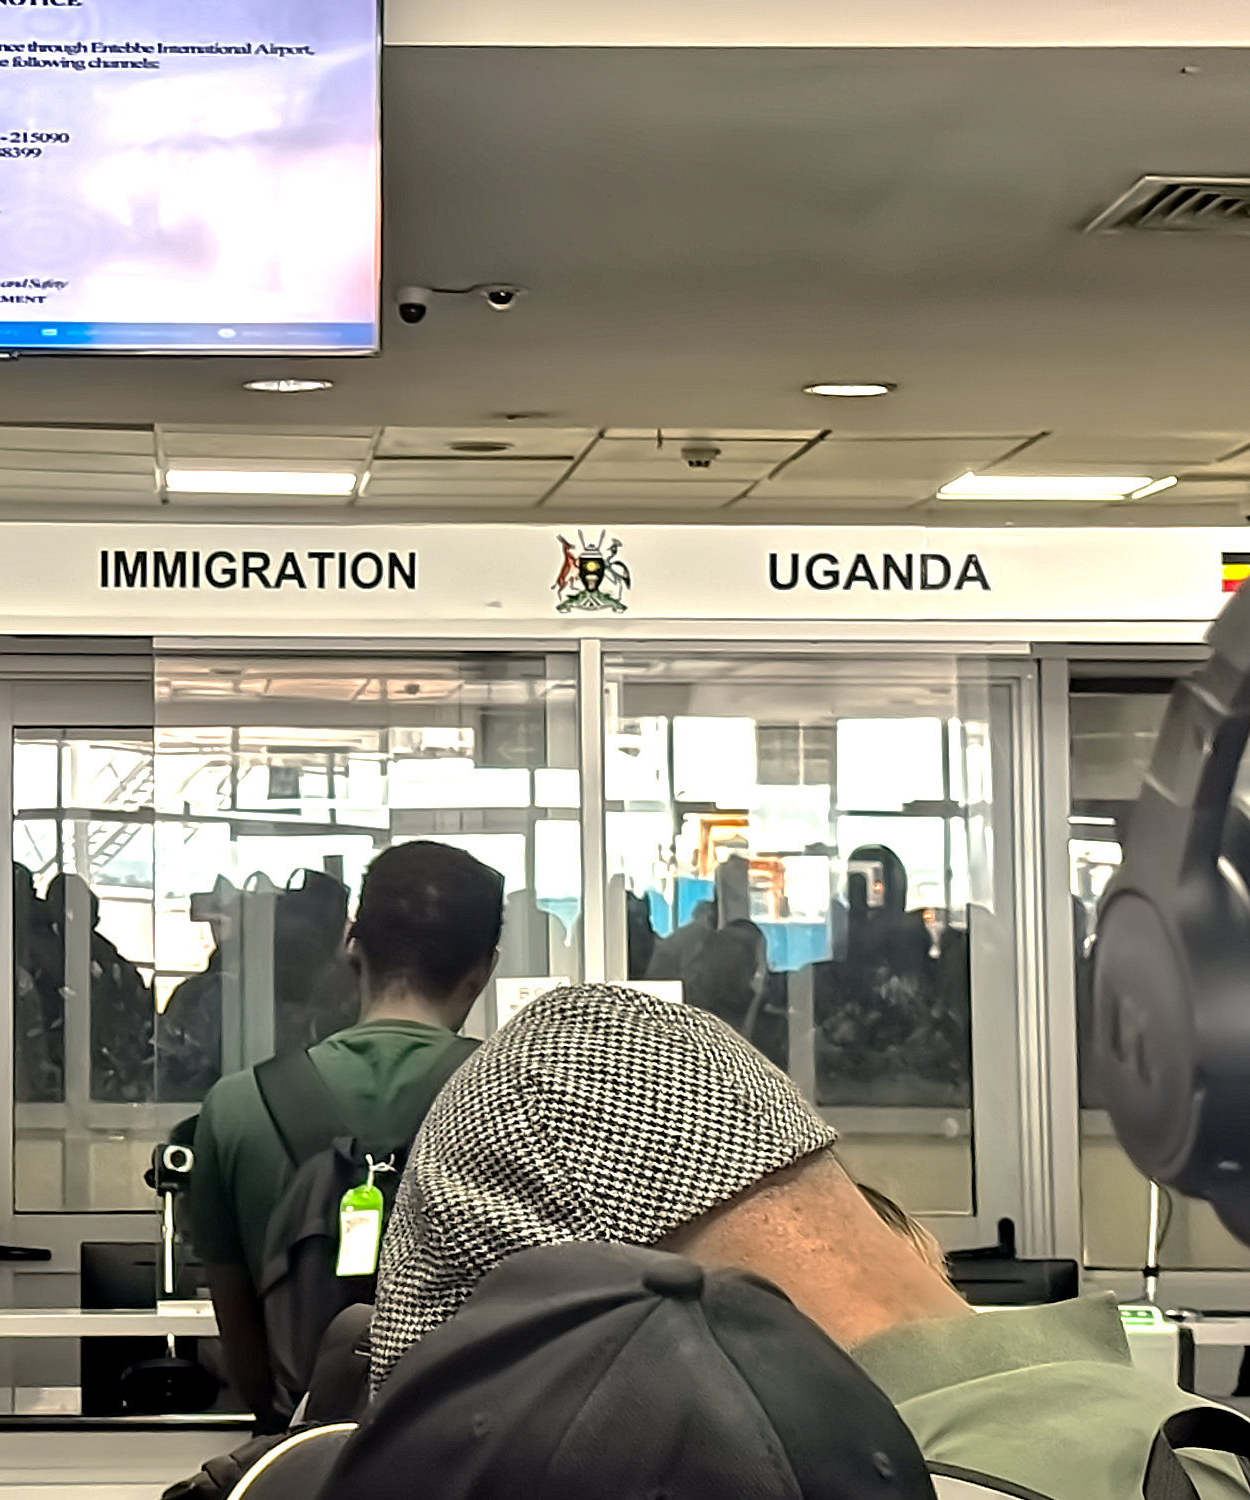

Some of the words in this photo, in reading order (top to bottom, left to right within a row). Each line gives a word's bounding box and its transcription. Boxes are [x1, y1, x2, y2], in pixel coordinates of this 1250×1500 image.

[28, 41, 87, 56] through
[92, 43, 153, 54] Entebbe
[158, 42, 251, 54] International
[12, 56, 85, 70] following
[1, 279, 28, 287] and
[28, 280, 68, 290] Safety
[100, 550, 416, 590] IMMIGRATION
[769, 553, 991, 591] UGANDA
